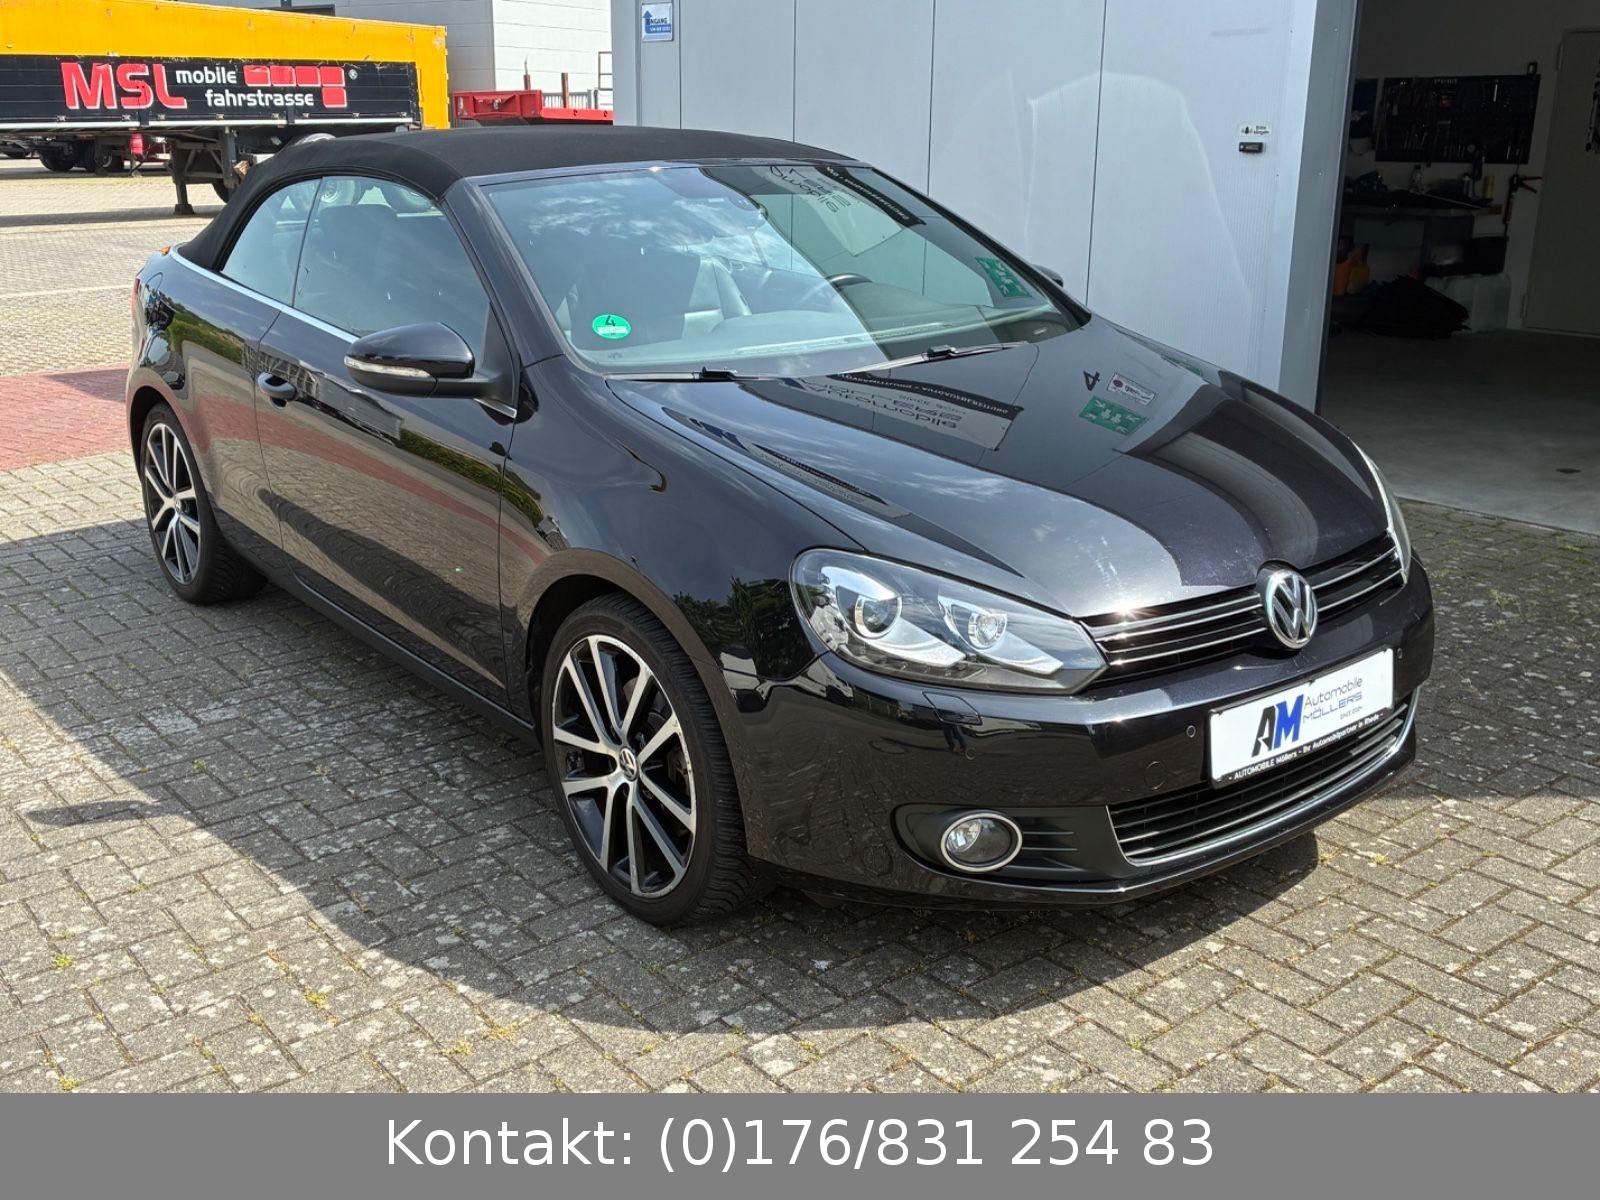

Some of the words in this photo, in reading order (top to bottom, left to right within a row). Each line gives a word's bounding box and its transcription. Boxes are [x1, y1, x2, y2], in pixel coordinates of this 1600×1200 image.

[61, 62, 187, 109] MSL
[176, 66, 237, 84] mobile
[205, 89, 314, 107] fahrstrasse
[604, 315, 616, 327] 4
[1304, 677, 1363, 709] Automobile
[1303, 691, 1363, 724] MÖLLERS
[1251, 694, 1304, 758] AM
[1234, 759, 1275, 780] AUTOMOBILE
